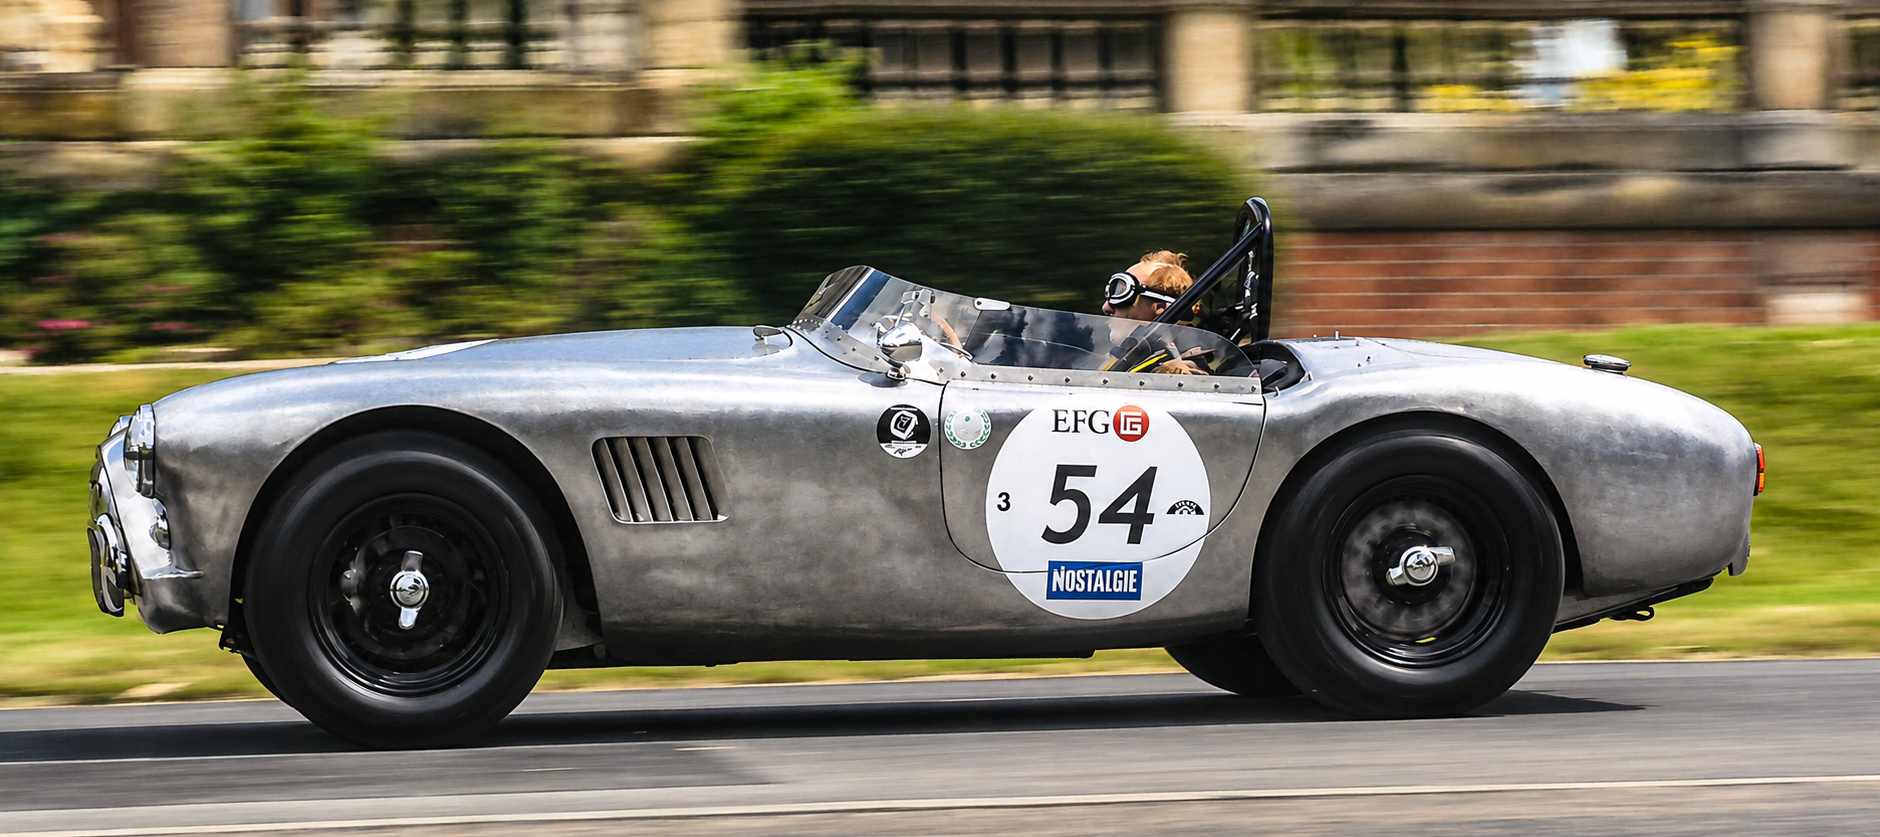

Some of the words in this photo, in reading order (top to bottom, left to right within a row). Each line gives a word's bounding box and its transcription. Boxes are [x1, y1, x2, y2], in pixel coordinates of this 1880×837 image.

[1052, 409, 1110, 434] EFG
[997, 492, 1011, 511] 3
[1041, 464, 1158, 545] 54
[1052, 565, 1138, 593] NOSTALGIE
